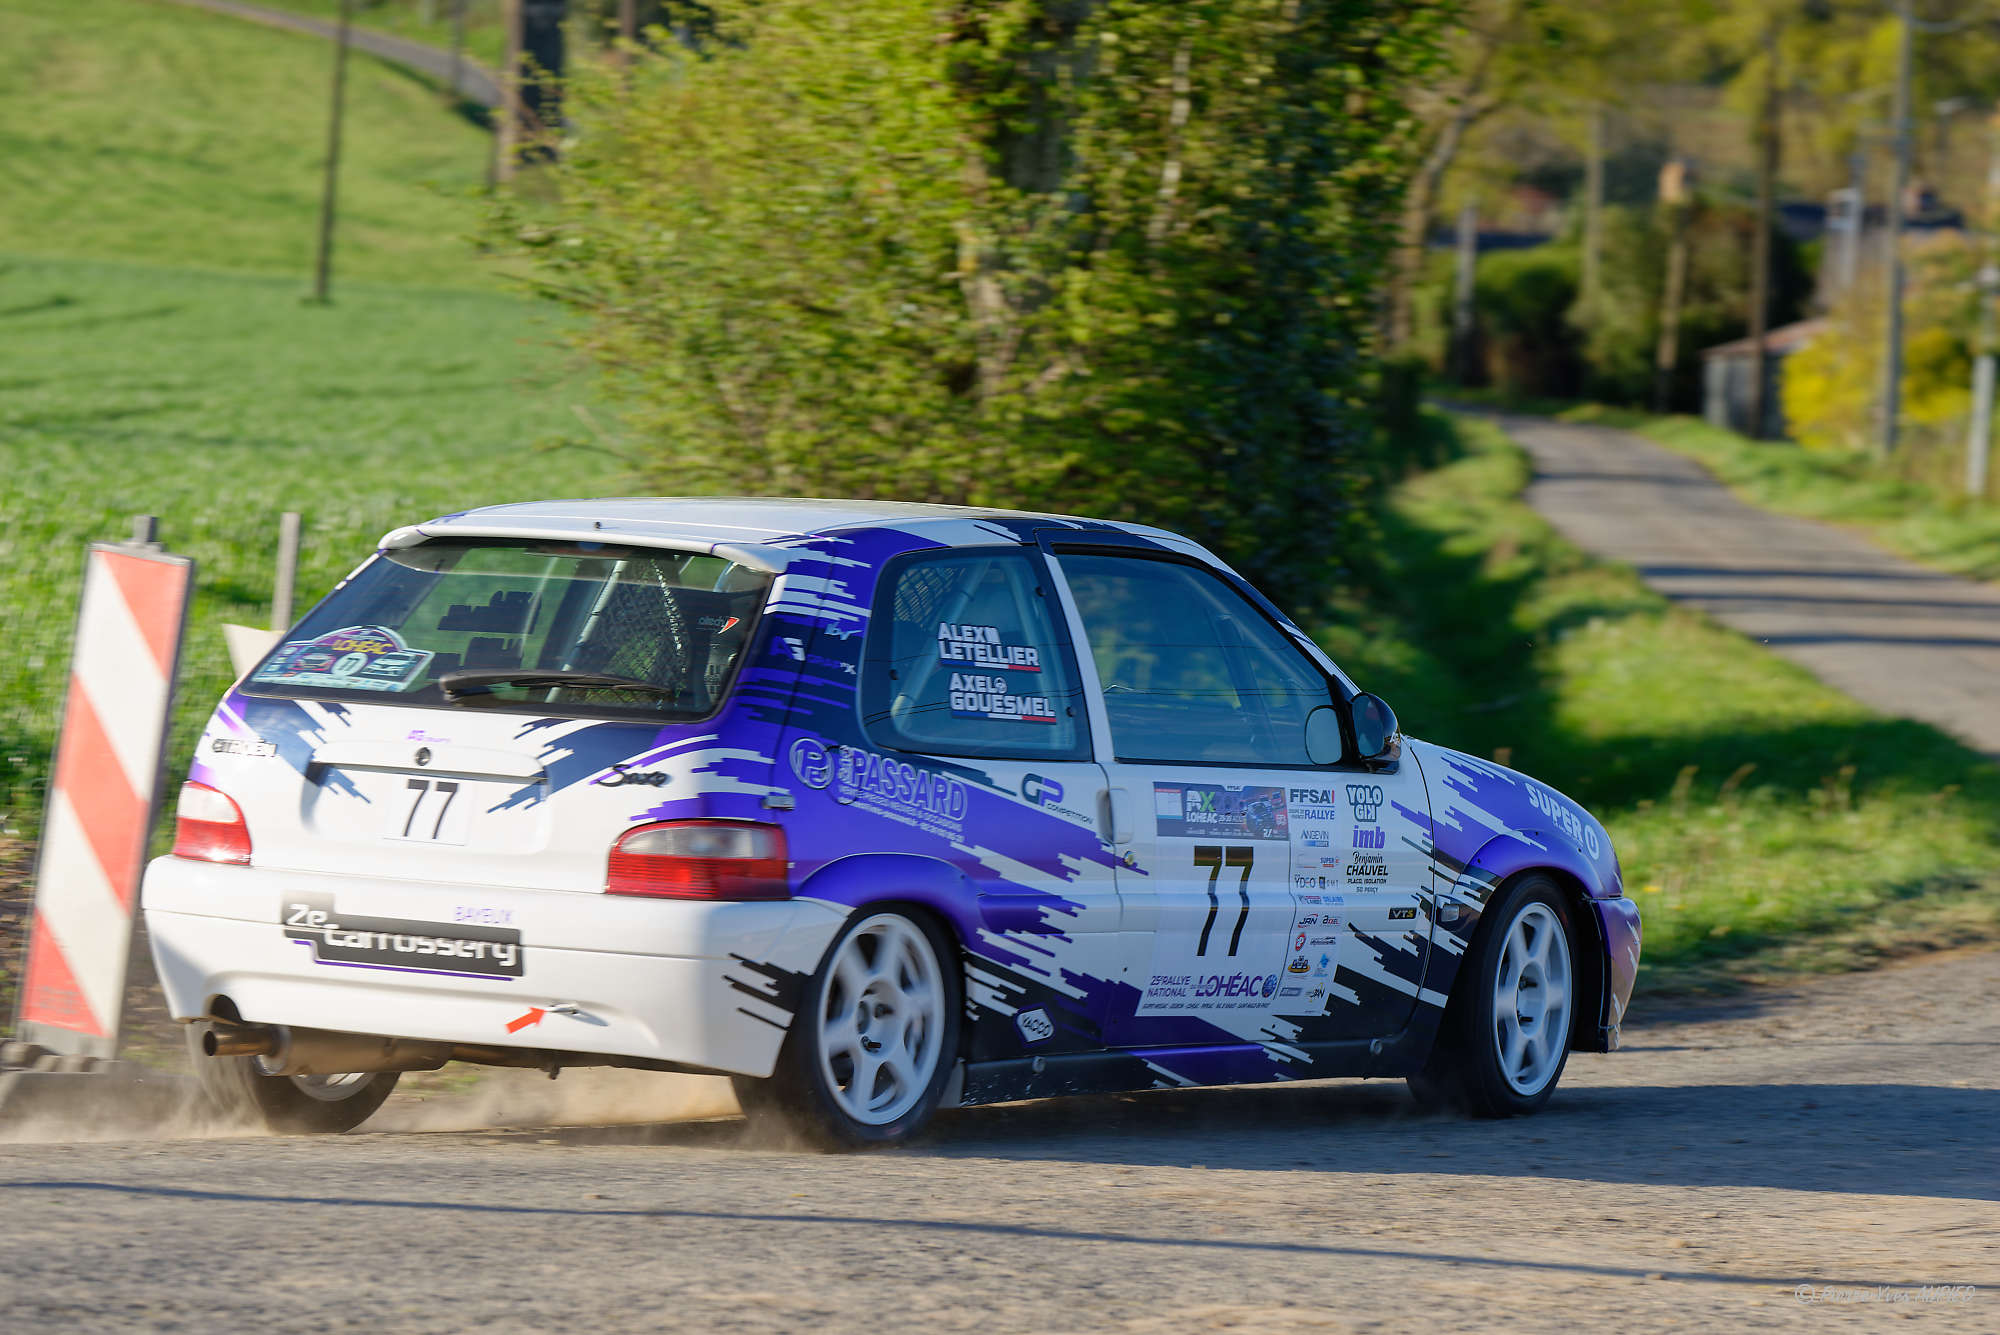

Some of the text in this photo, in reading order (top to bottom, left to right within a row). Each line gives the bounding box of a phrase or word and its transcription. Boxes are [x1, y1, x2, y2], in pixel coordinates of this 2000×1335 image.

[938, 623, 984, 642] ALEX
[939, 641, 1040, 666] LETELLIER
[950, 673, 994, 693] AXEL
[950, 692, 1055, 717] GOUESMEL
[597, 763, 668, 788] Saxo
[849, 747, 968, 821] PASSARD
[1290, 788, 1330, 803] FFSA
[1346, 785, 1383, 805] YOLO
[403, 778, 459, 840] 77
[1304, 809, 1335, 820] RALLYE
[1525, 783, 1584, 843] SUPER
[1353, 825, 1385, 848] imb
[1353, 851, 1383, 866] Benjamin
[1346, 865, 1388, 876] CHAUVEL
[1194, 846, 1254, 957] 77
[1391, 909, 1414, 918] VTS
[1147, 988, 1186, 997] NATIONAL
[1195, 972, 1262, 997] LOHÉAC
